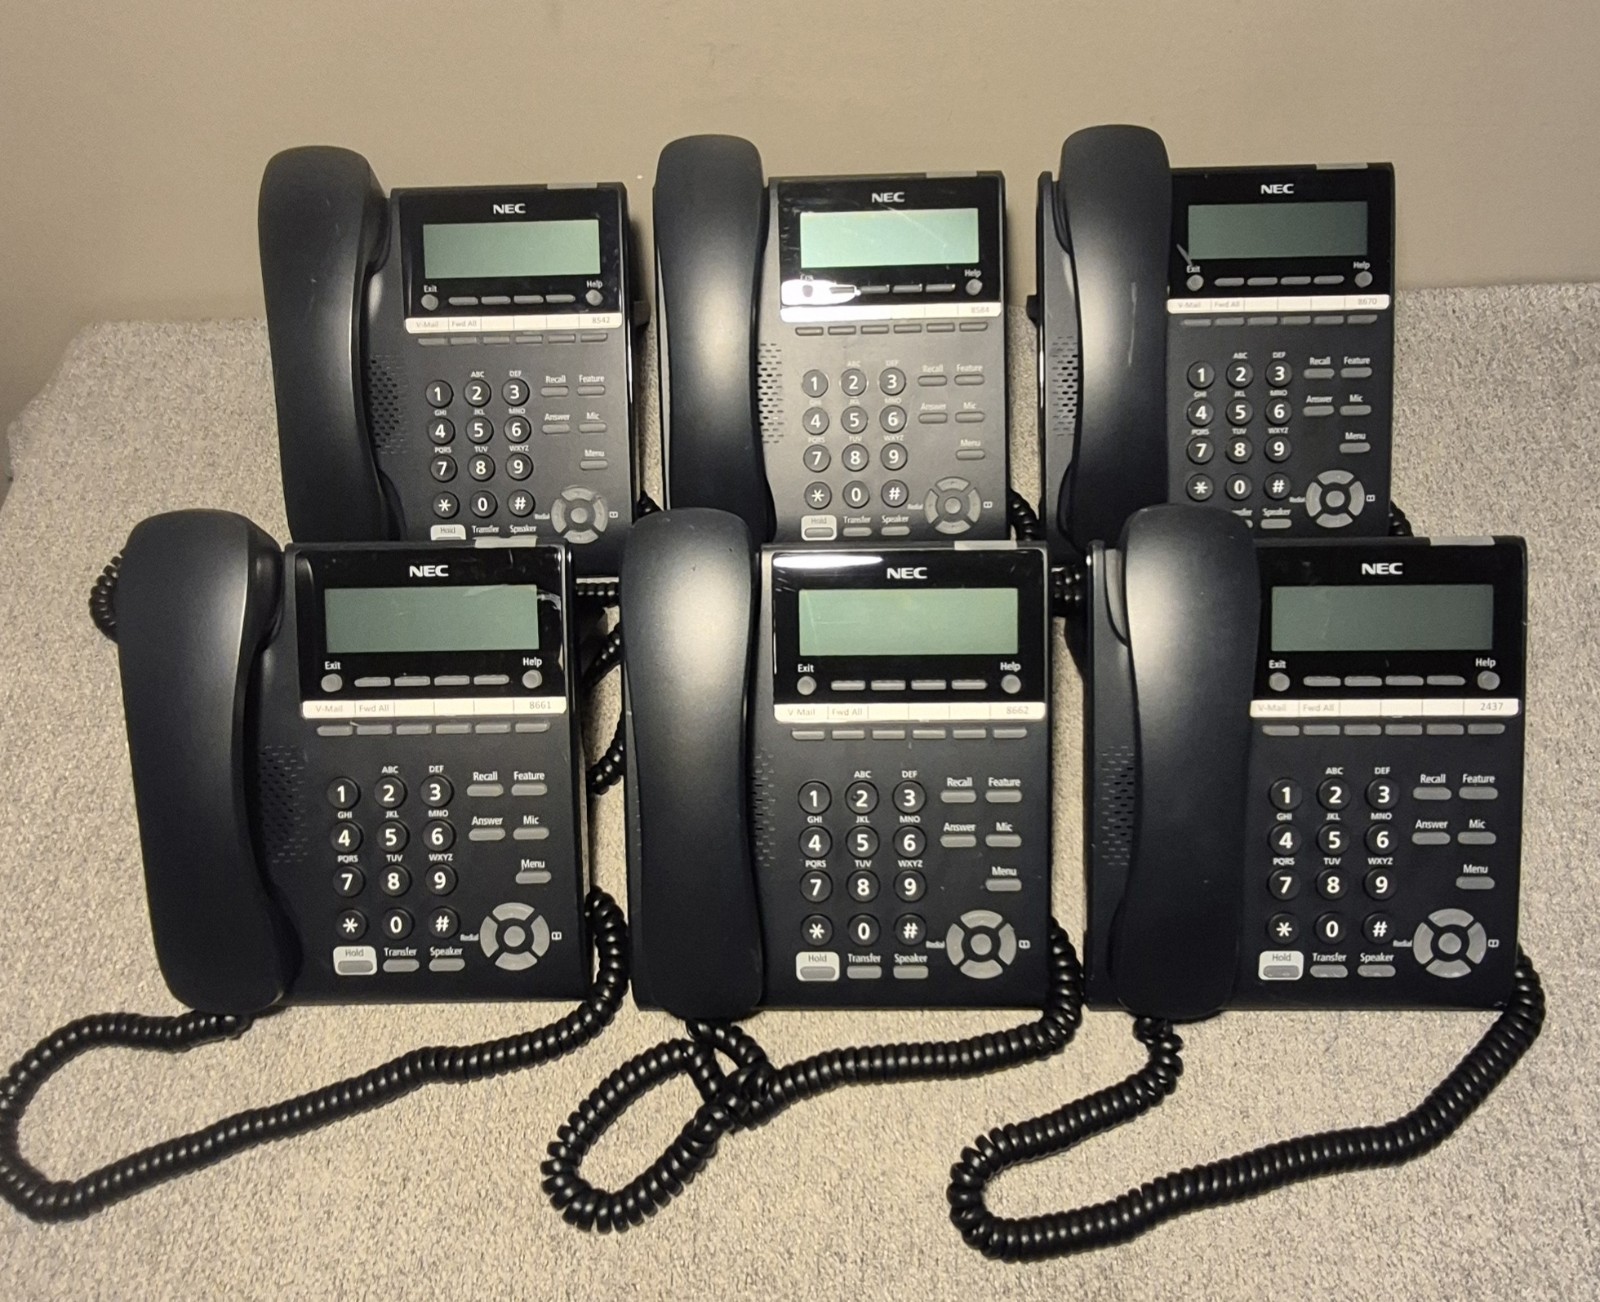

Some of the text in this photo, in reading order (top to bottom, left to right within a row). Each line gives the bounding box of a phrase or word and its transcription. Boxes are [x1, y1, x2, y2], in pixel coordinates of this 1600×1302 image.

[1261, 184, 1294, 194] NEC
[872, 192, 905, 202] NEC
[493, 203, 526, 214] NEC
[1187, 265, 1200, 273] Exit
[1353, 261, 1370, 270] Help
[964, 269, 981, 278] Help
[423, 284, 438, 293] Exit
[587, 280, 603, 289] Help
[591, 316, 611, 324] 8542
[1310, 357, 1331, 365] Recall
[1344, 356, 1370, 365] Feature
[956, 364, 983, 372] Feature
[1275, 366, 1285, 381] 3
[546, 375, 566, 383] Recall
[579, 375, 604, 383] Feature
[1197, 368, 1205, 382] 1
[1236, 367, 1246, 381] 2
[811, 377, 818, 390] 1
[849, 376, 858, 389] 2
[887, 374, 897, 388] 3
[433, 387, 441, 401] 1
[472, 386, 482, 400] 2
[510, 385, 520, 399] 3
[1350, 394, 1363, 402] Mic
[963, 401, 976, 409] Mic
[587, 412, 599, 420] Mic
[1196, 406, 1207, 420] 4
[1235, 405, 1246, 419] 5
[1274, 405, 1284, 418] 6
[810, 414, 821, 428] 4
[850, 412, 860, 427] 5
[888, 412, 898, 426] 6
[435, 424, 445, 438] 4
[474, 423, 483, 437] 5
[512, 423, 521, 436] 6
[1346, 432, 1366, 440] Menu
[960, 439, 981, 447] Menu
[584, 449, 604, 457] Menu
[1196, 443, 1207, 457] 7
[1234, 442, 1245, 456] 8
[1274, 442, 1284, 456] 9
[812, 451, 822, 465] 7
[850, 450, 861, 465] 8
[889, 450, 899, 464] 9
[438, 462, 447, 476] 7
[476, 460, 486, 475] 8
[513, 460, 524, 474] 9
[1234, 480, 1245, 494] 0
[851, 488, 862, 501] 0
[478, 497, 488, 511] 0
[1262, 508, 1290, 516] Speaker
[882, 515, 909, 524] Speaker
[510, 525, 537, 534] Speaker
[409, 564, 449, 577] NEC
[887, 567, 927, 579] NEC
[1361, 562, 1403, 575] NEC
[324, 661, 341, 670] Exit
[522, 657, 542, 666] Help
[1000, 662, 1021, 672] Help
[1269, 660, 1286, 669] Exit
[1475, 658, 1496, 668] Help
[797, 664, 814, 673] Exit
[529, 700, 551, 709] 8661
[1006, 706, 1029, 714] 8662
[1480, 702, 1503, 711] 2437
[382, 766, 398, 774] ABC
[429, 765, 444, 773] DEF
[854, 770, 871, 778] ABC
[902, 770, 918, 778] DEF
[1325, 767, 1343, 775] ABC
[473, 771, 498, 781] Recall
[514, 771, 545, 780] Feature
[1420, 774, 1446, 784] Recall
[1462, 774, 1495, 784] Feature
[947, 777, 972, 787] Recall
[988, 777, 1021, 787] Feature
[337, 786, 345, 802] 1
[383, 785, 394, 801] 2
[430, 784, 441, 800] 3
[1281, 786, 1291, 803] 1
[1329, 786, 1342, 803] 2
[1378, 786, 1390, 803] 3
[809, 790, 818, 807] 1
[856, 790, 868, 806] 2
[904, 790, 916, 806] 3
[338, 811, 352, 819] GHI
[472, 816, 502, 825] Answer
[523, 815, 539, 824] Mic
[1276, 813, 1292, 821] GHI
[943, 822, 975, 832] Answer
[996, 822, 1012, 832] Mic
[1415, 820, 1448, 829] Answer
[1469, 819, 1485, 829] Mic
[338, 830, 350, 846] 4
[385, 829, 397, 845] 5
[431, 828, 443, 845] 6
[857, 834, 868, 850] 5
[904, 834, 916, 850] 6
[1279, 832, 1292, 848] 4
[1328, 831, 1341, 848] 5
[1376, 831, 1389, 848] 6
[808, 835, 821, 851] 4
[337, 855, 358, 863] PQRS
[386, 854, 403, 862] TUV
[521, 859, 545, 868] Menu
[805, 860, 826, 868] PQRS
[1463, 865, 1488, 874] Menu
[992, 866, 1017, 876] Menu
[341, 874, 352, 890] 7
[388, 873, 399, 890] 8
[434, 872, 446, 889] 9
[1279, 876, 1292, 893] 7
[1327, 876, 1340, 893] 8
[1375, 876, 1388, 893] 9
[810, 879, 822, 895] 7
[857, 878, 870, 895] 8
[904, 878, 916, 895] 9
[390, 917, 402, 933] 0
[436, 916, 449, 932] #
[1326, 921, 1338, 937] 0
[1373, 921, 1387, 936] #
[858, 923, 870, 939] 0
[903, 922, 918, 938] #
[345, 949, 364, 957] Hold
[384, 947, 417, 956] Transfer
[430, 947, 463, 957] Speaker
[808, 954, 827, 962] Hold
[848, 954, 881, 962] Transfer
[895, 953, 927, 964] Speaker
[1272, 953, 1291, 962] Hold
[1312, 953, 1346, 962] Transfer
[1360, 953, 1394, 963] Speaker
